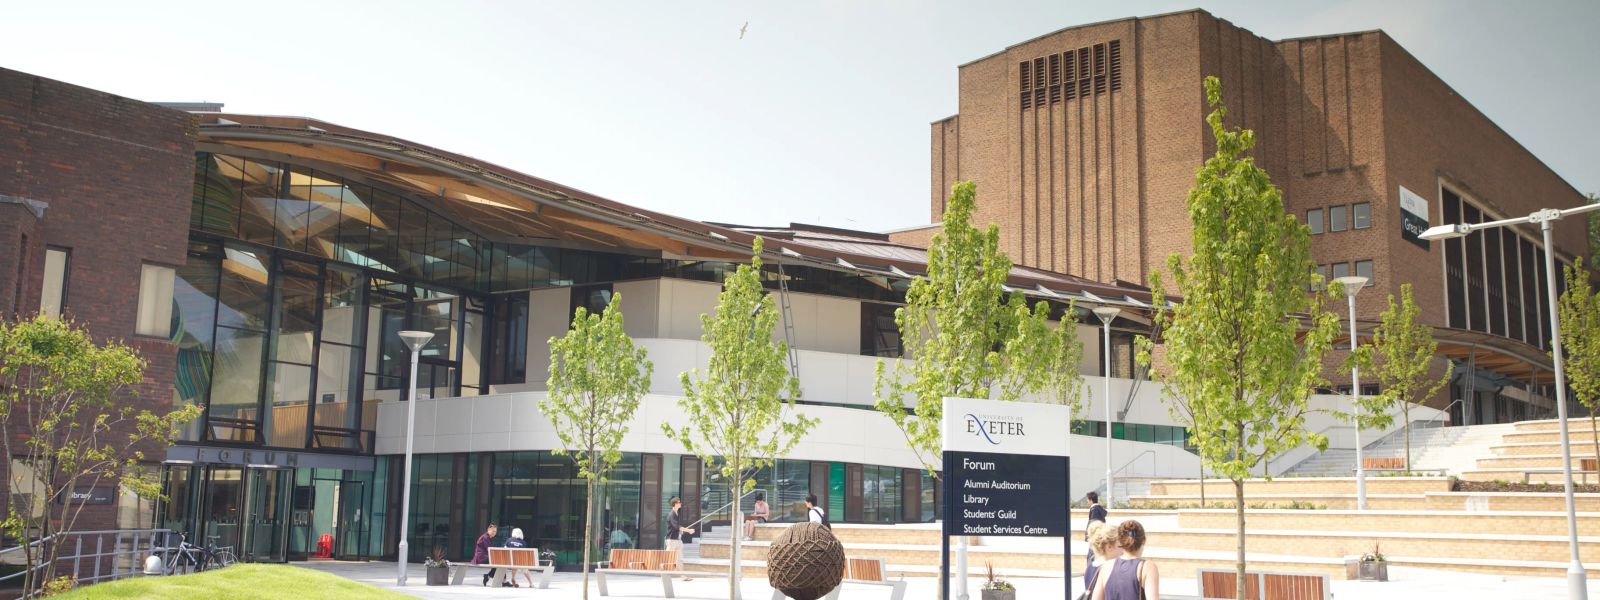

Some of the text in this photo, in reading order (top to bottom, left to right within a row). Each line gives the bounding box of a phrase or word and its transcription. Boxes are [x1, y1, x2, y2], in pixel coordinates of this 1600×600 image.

[1404, 218, 1418, 235] Great
[198, 448, 298, 466] FORUM
[963, 458, 995, 471] Forum
[964, 480, 1031, 490] Alumni Auditorium
[963, 494, 989, 506] Library
[997, 510, 1017, 519] Guild
[963, 524, 1048, 535] Student Services Centre
